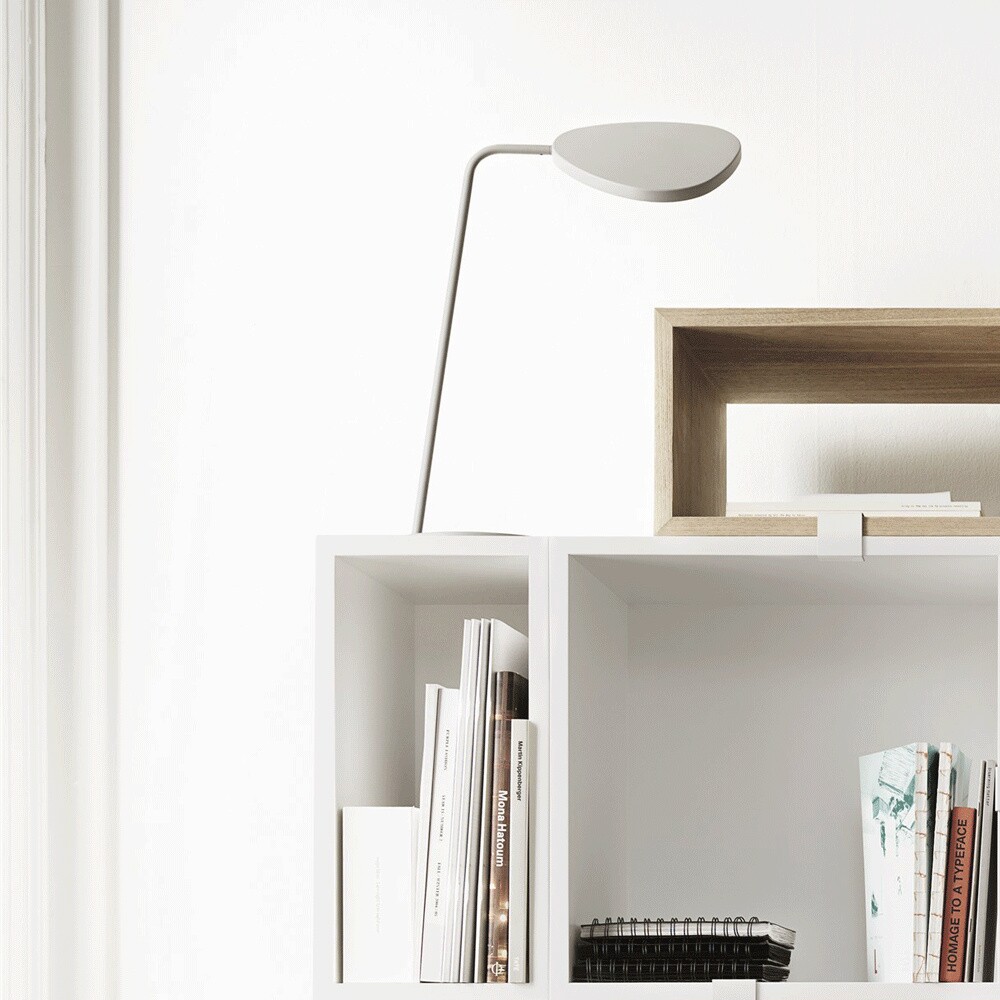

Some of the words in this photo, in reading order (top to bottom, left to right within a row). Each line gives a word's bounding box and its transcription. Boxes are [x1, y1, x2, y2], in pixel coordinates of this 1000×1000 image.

[516, 741, 524, 760] Martin
[514, 760, 524, 802] Kippenberger
[497, 790, 508, 822] Mona
[495, 823, 508, 867] Hatoum
[954, 818, 968, 882] TYPEFACE
[950, 898, 962, 914] TO
[952, 886, 962, 894] A
[946, 918, 960, 972] HOMAGE
